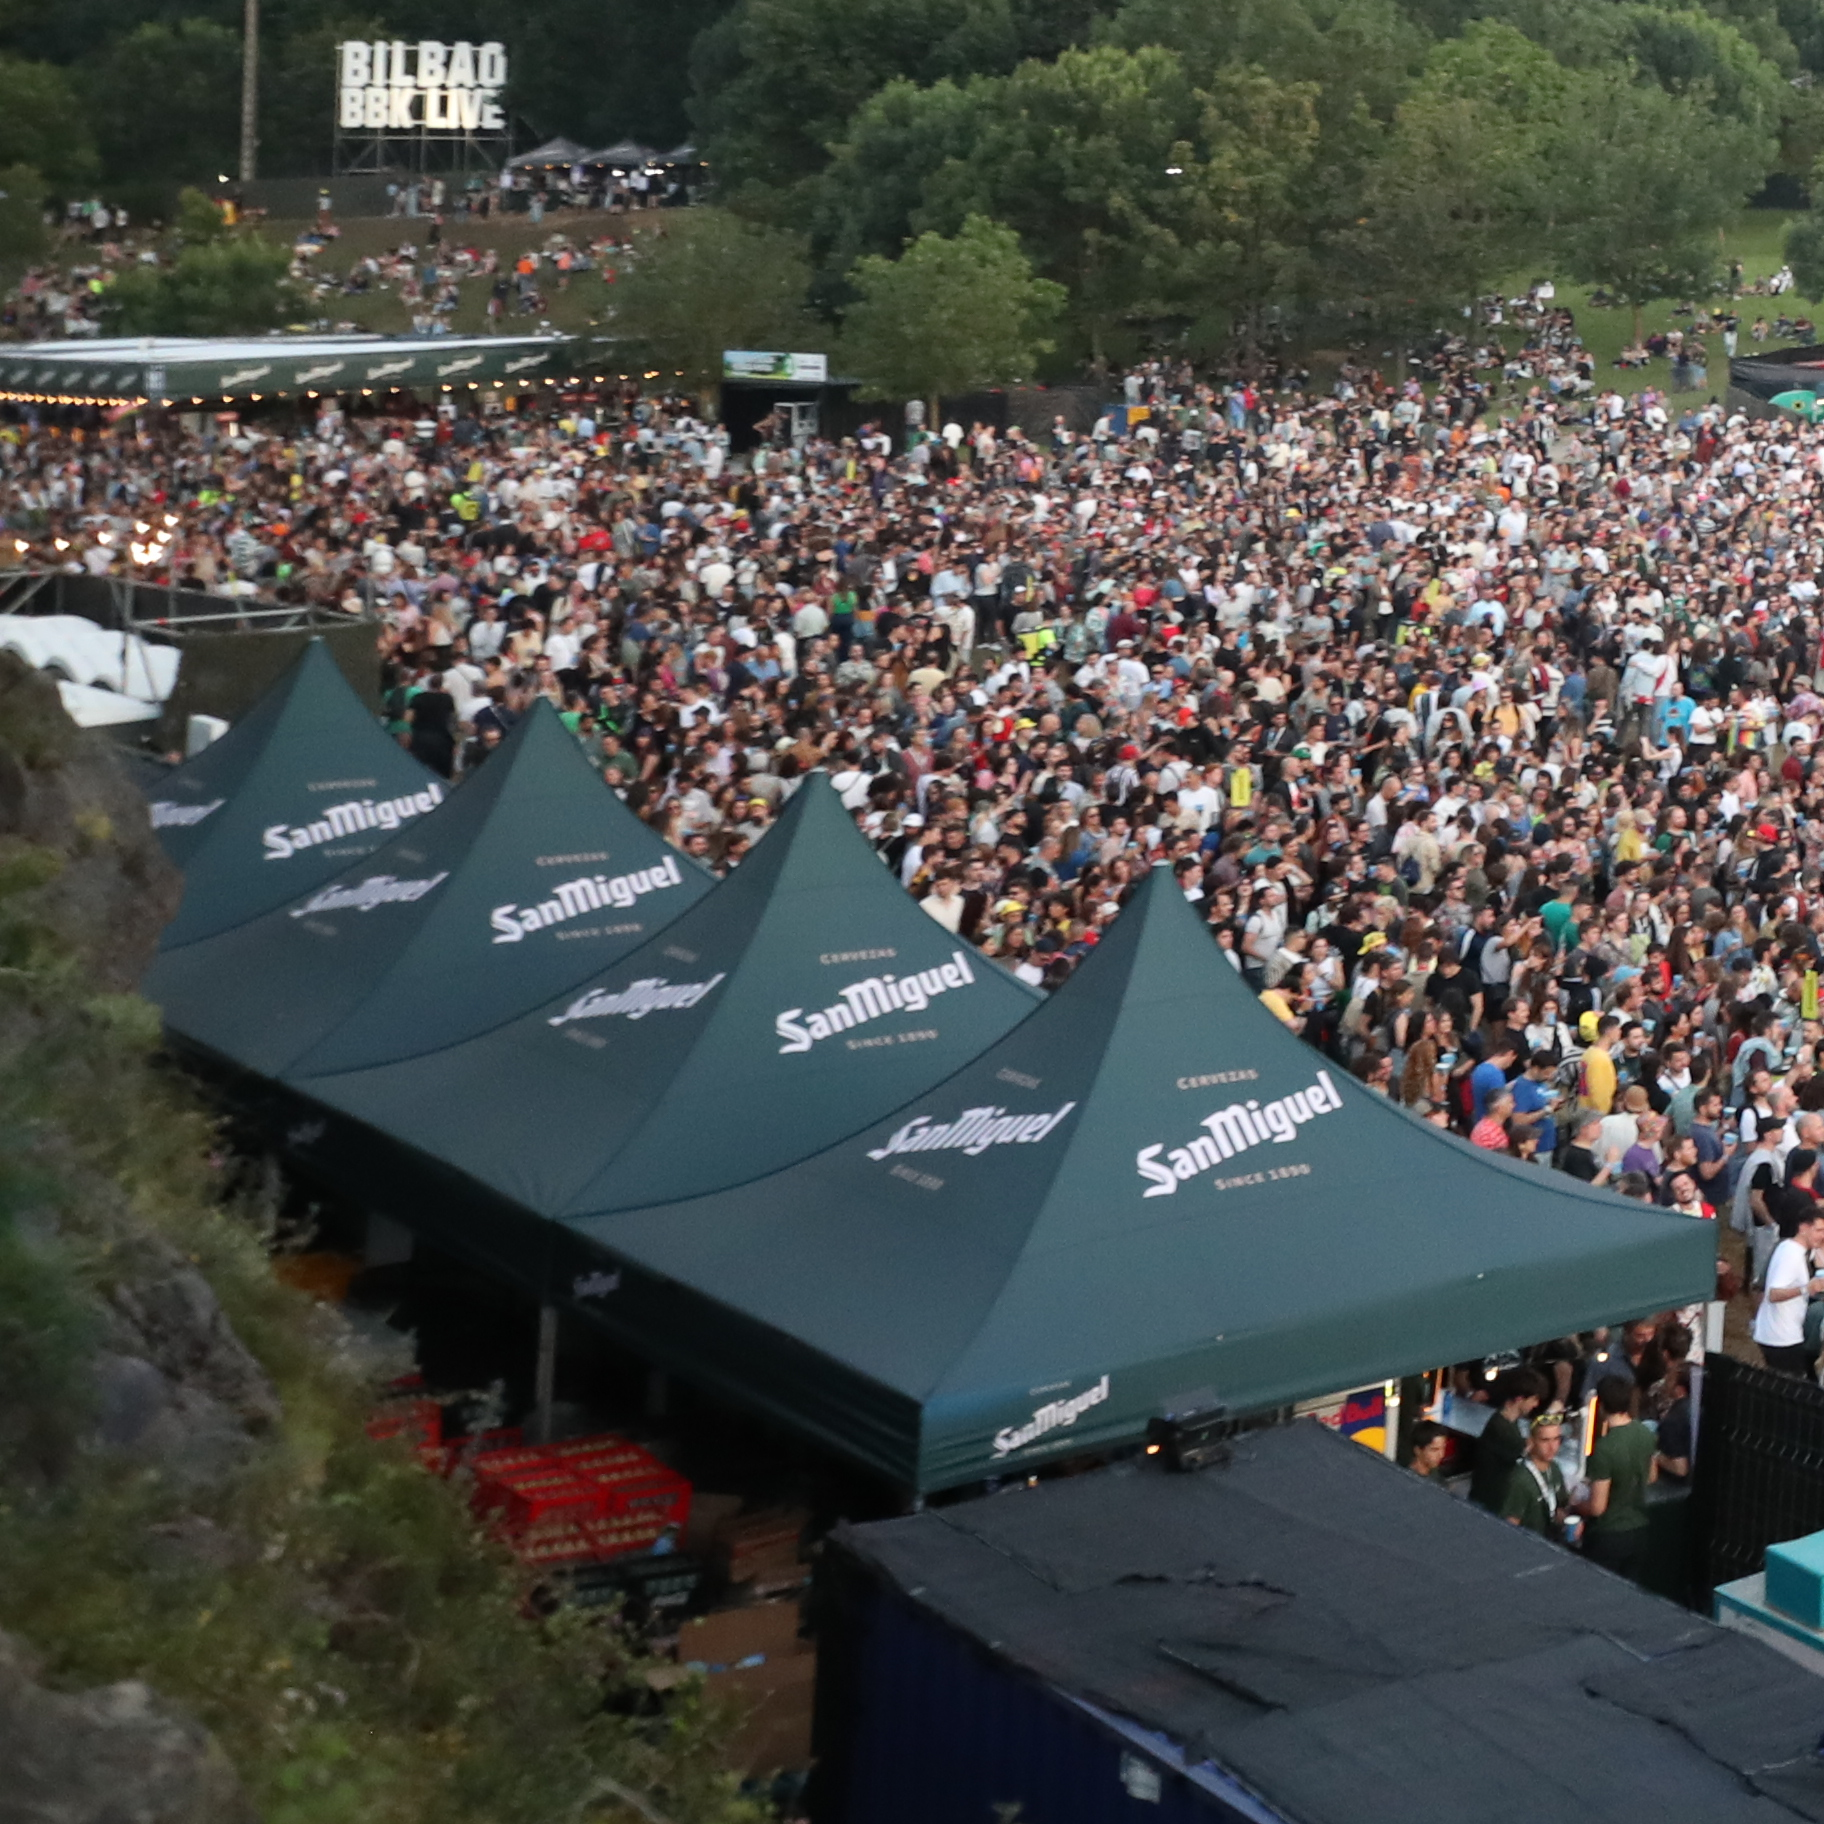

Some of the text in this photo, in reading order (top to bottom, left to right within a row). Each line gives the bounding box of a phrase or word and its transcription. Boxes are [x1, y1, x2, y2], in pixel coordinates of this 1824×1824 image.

[342, 40, 508, 88] BILBAO
[340, 87, 507, 130] BBK LIVE
